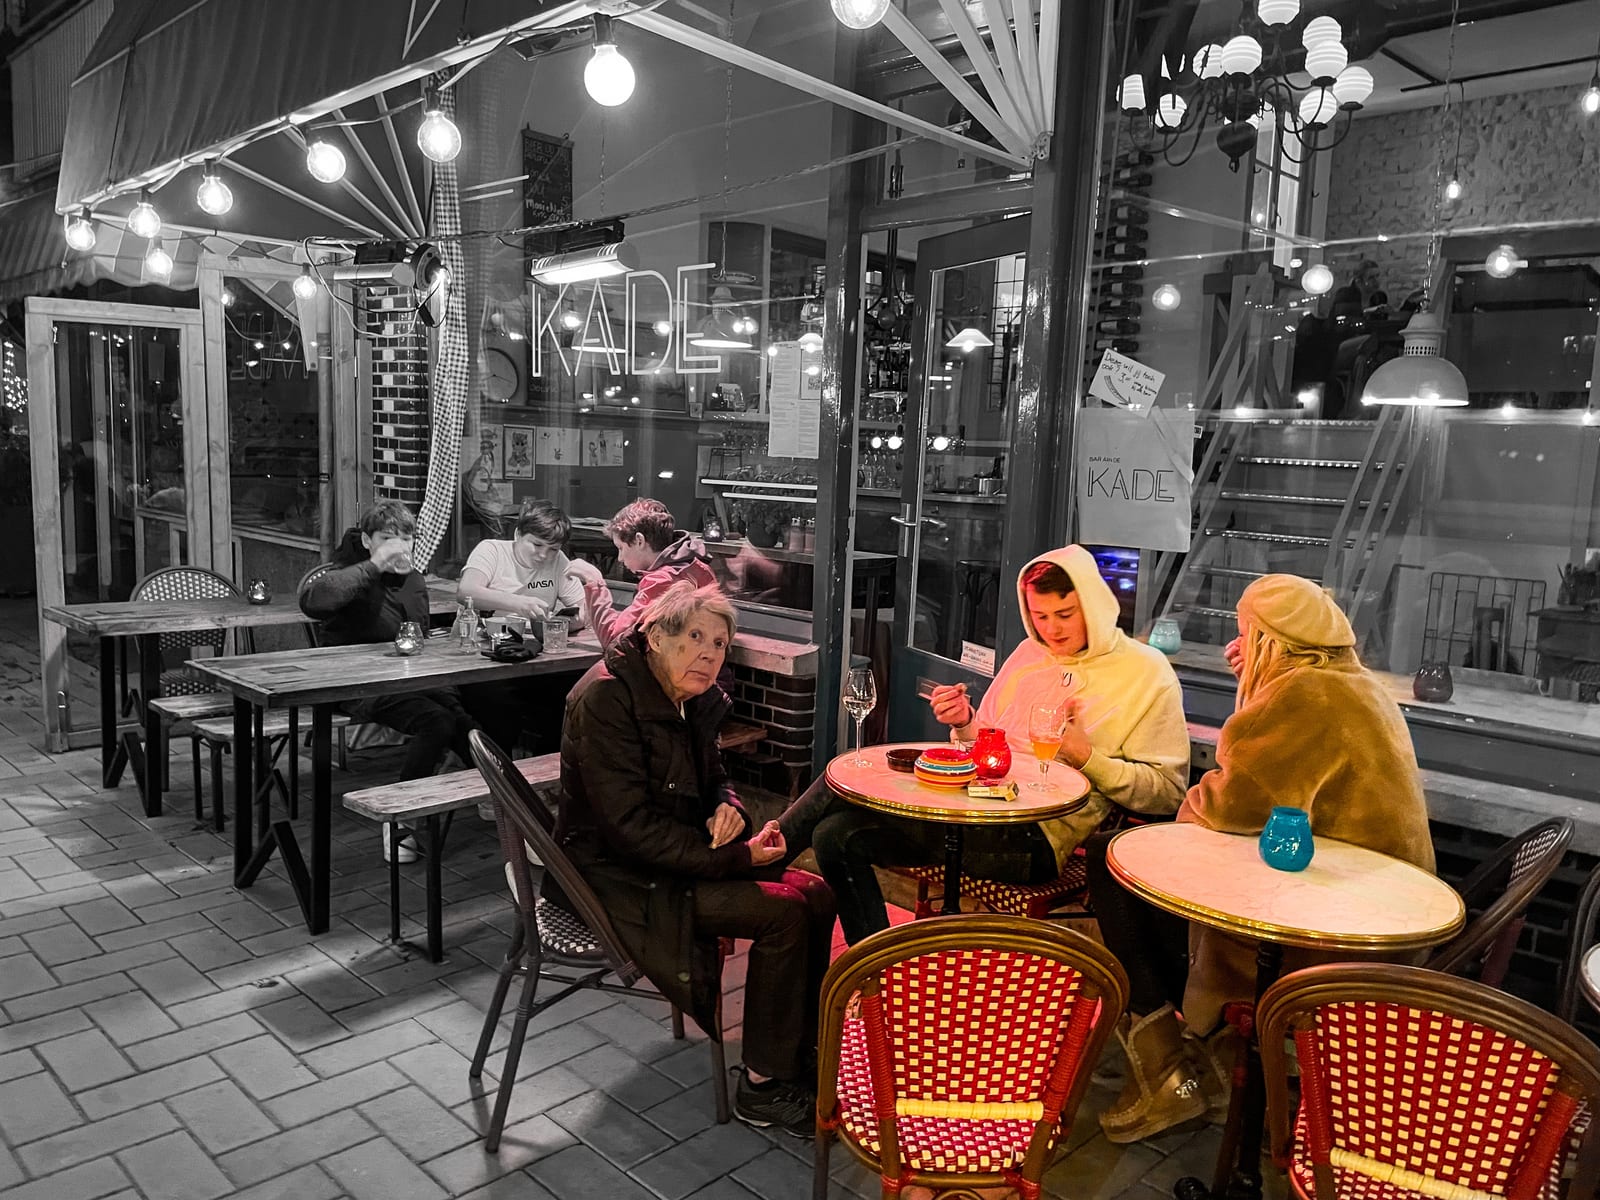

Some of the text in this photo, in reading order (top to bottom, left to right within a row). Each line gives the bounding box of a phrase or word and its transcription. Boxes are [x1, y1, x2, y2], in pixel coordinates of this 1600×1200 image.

[532, 259, 721, 377] KADE
[1087, 467, 1175, 502] KADE
[527, 579, 554, 590] NASA
